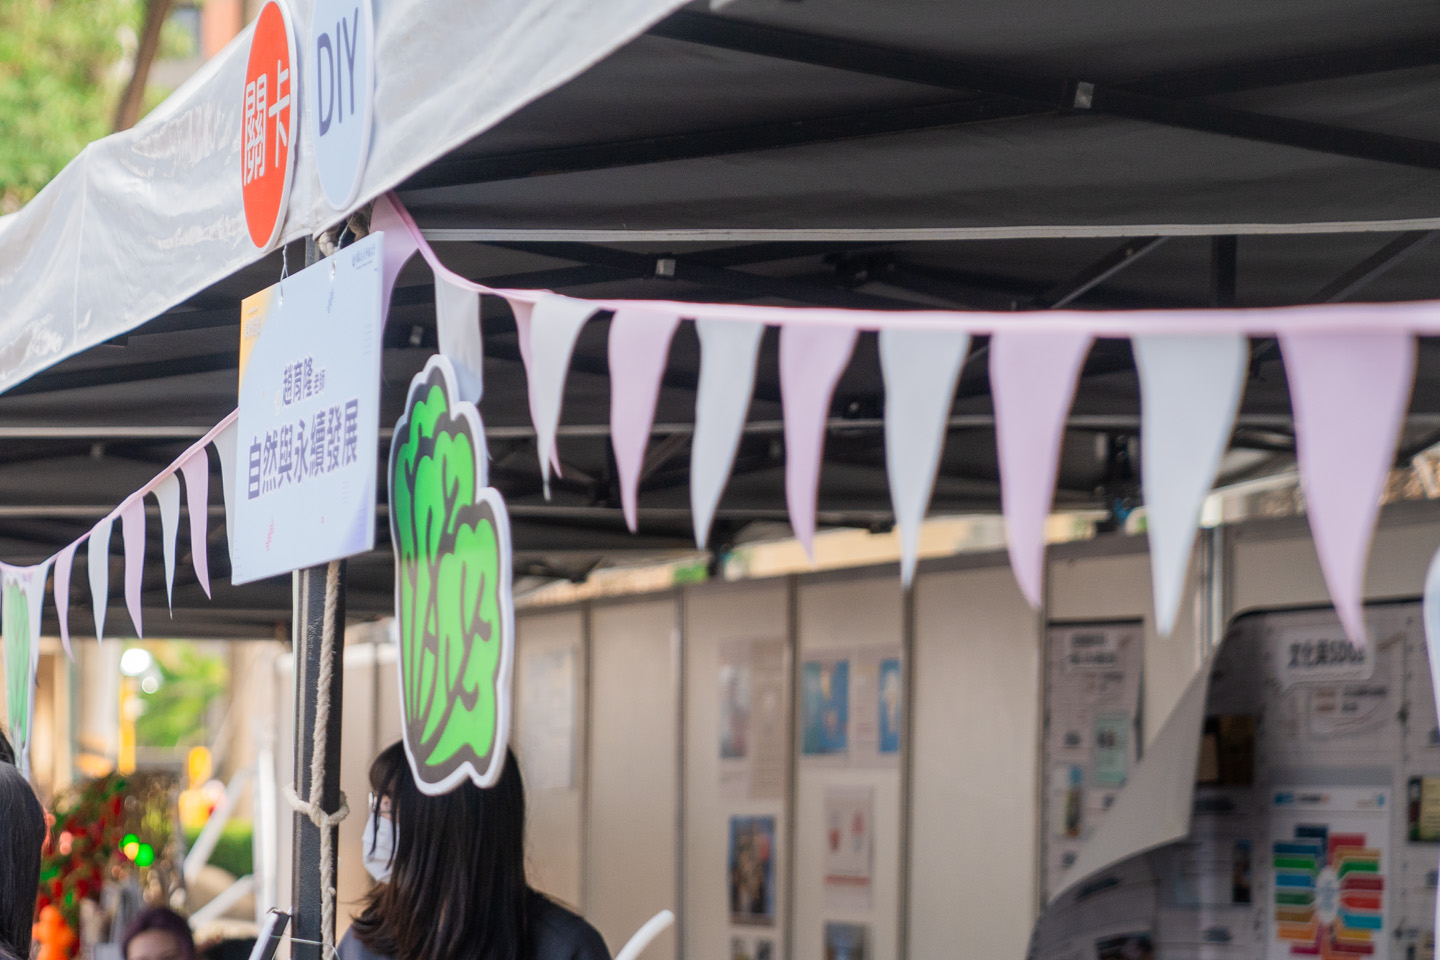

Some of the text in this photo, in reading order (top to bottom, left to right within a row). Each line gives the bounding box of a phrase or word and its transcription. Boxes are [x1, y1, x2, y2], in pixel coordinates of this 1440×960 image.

[244, 59, 291, 187] 關卡
[317, 7, 358, 137] DIY
[248, 398, 359, 500] 自然與永續發展
